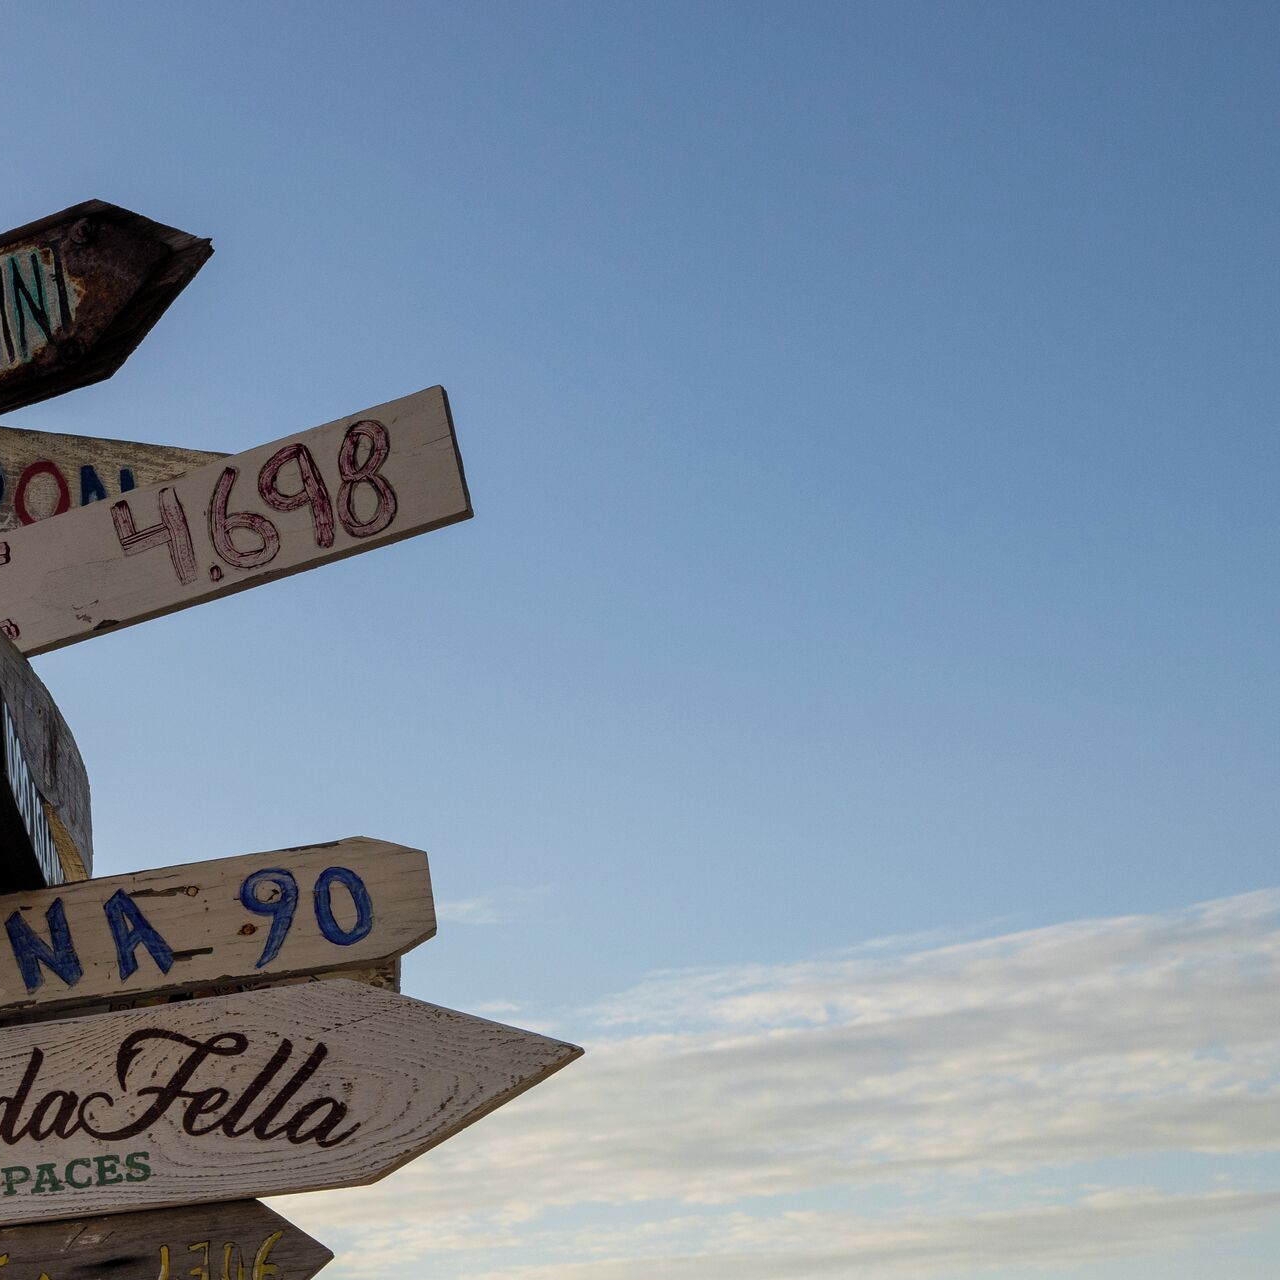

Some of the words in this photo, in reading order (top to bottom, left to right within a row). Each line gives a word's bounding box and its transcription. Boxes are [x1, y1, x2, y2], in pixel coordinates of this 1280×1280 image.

[110, 419, 397, 586] 4.698
[242, 865, 375, 970] 90
[1, 1150, 153, 1199] PACES
